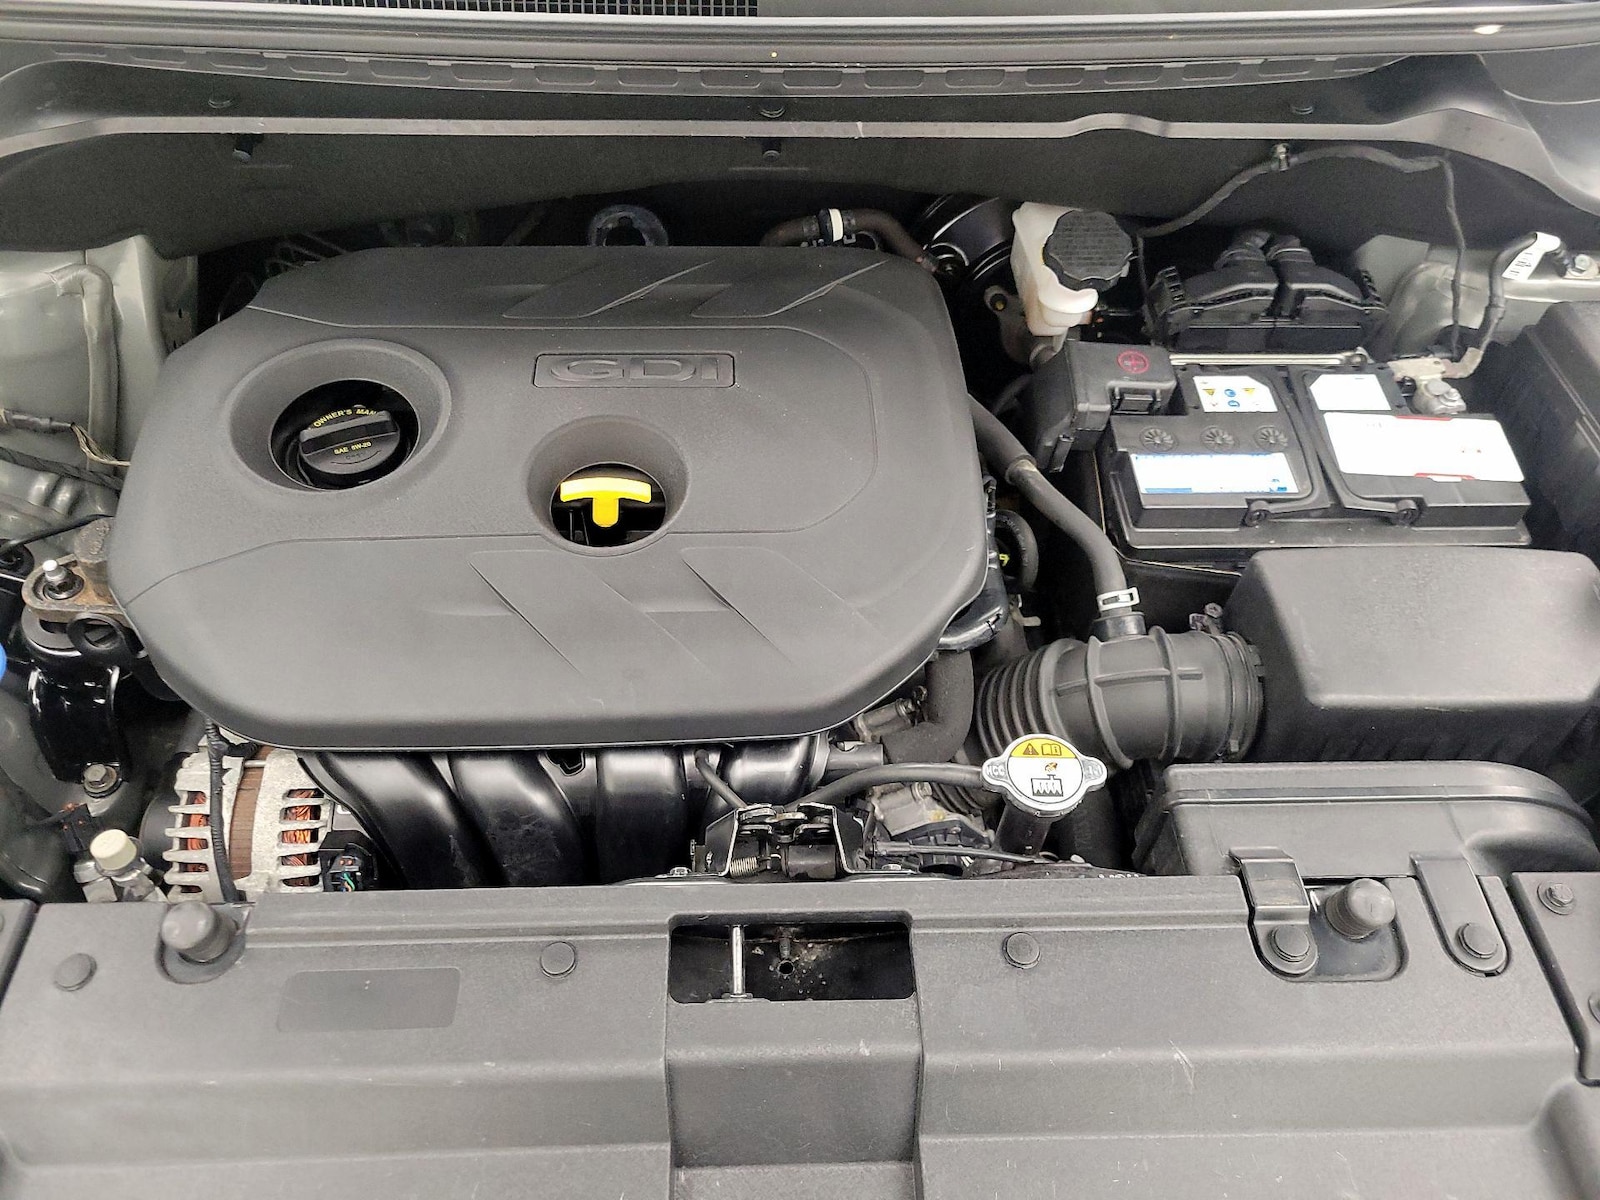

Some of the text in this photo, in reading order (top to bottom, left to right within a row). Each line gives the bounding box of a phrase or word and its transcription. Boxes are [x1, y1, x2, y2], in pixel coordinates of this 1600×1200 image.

[550, 357, 719, 382] GDI
[313, 408, 352, 427] OWNER'S
[334, 446, 349, 455] SAE
